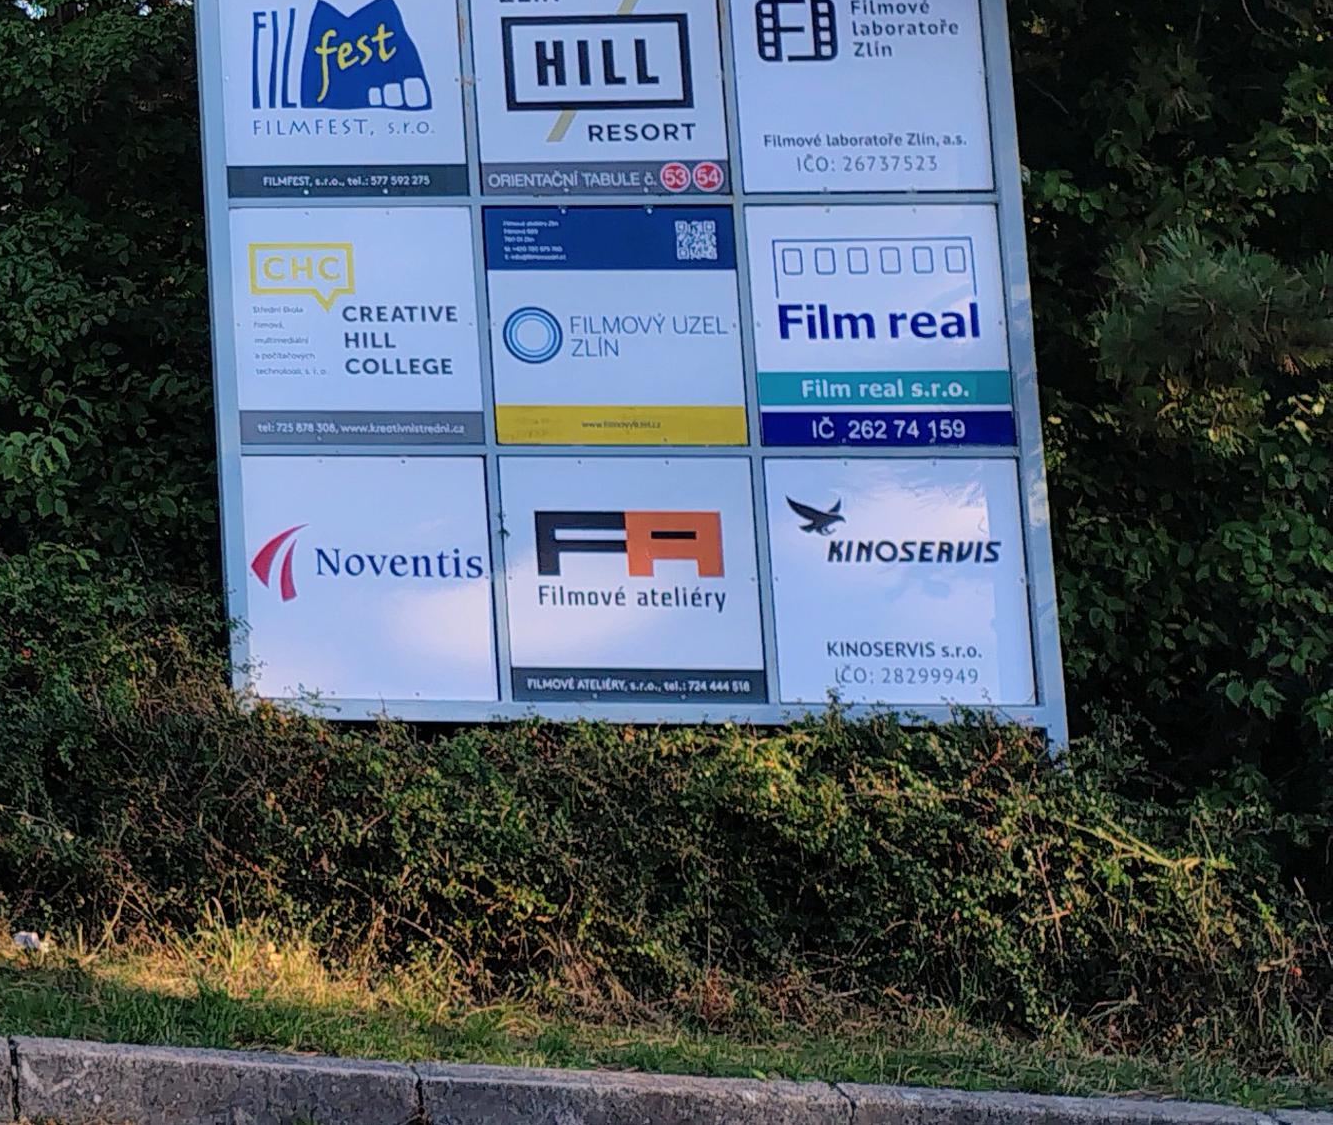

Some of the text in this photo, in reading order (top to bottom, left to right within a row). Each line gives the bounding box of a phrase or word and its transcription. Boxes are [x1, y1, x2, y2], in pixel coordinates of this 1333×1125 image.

[852, 19, 959, 37] laboratoře
[853, 41, 893, 58] Zlín
[314, 23, 397, 103] fest
[535, 38, 659, 87] HILL
[253, 119, 435, 136] FILMFEST, s.r.o.
[588, 123, 696, 142] RESORT
[764, 132, 968, 148] Filmové laboratoře Zlín, a.s.
[797, 154, 938, 173] IČO: 26737523
[370, 176, 389, 186] 577
[391, 175, 410, 186] 592
[488, 167, 719, 188] ORIENTAČNÍ TABULE č. 53 54
[261, 256, 341, 281] CHC
[342, 305, 458, 323] CREATIVE
[570, 313, 728, 335] FILMOVÝ UZEL
[778, 302, 981, 340] Film real
[344, 332, 396, 349] HILL
[571, 337, 619, 357] ZLÍN
[345, 358, 454, 376] COLLEGE
[801, 378, 970, 398] Film real s.r.o.
[812, 416, 966, 440] IČ 262 74 159
[534, 510, 725, 577] FA
[827, 540, 1002, 563] KINOSERVIS
[314, 548, 483, 579] Noventis
[538, 585, 727, 613] Filmové ateliéry
[827, 641, 983, 659] KINOSERVIS s.r.o.
[527, 676, 574, 691] FILMOVÉ
[577, 677, 628, 693] ATELIÉRY,
[835, 664, 979, 685] IČO: 28299949
